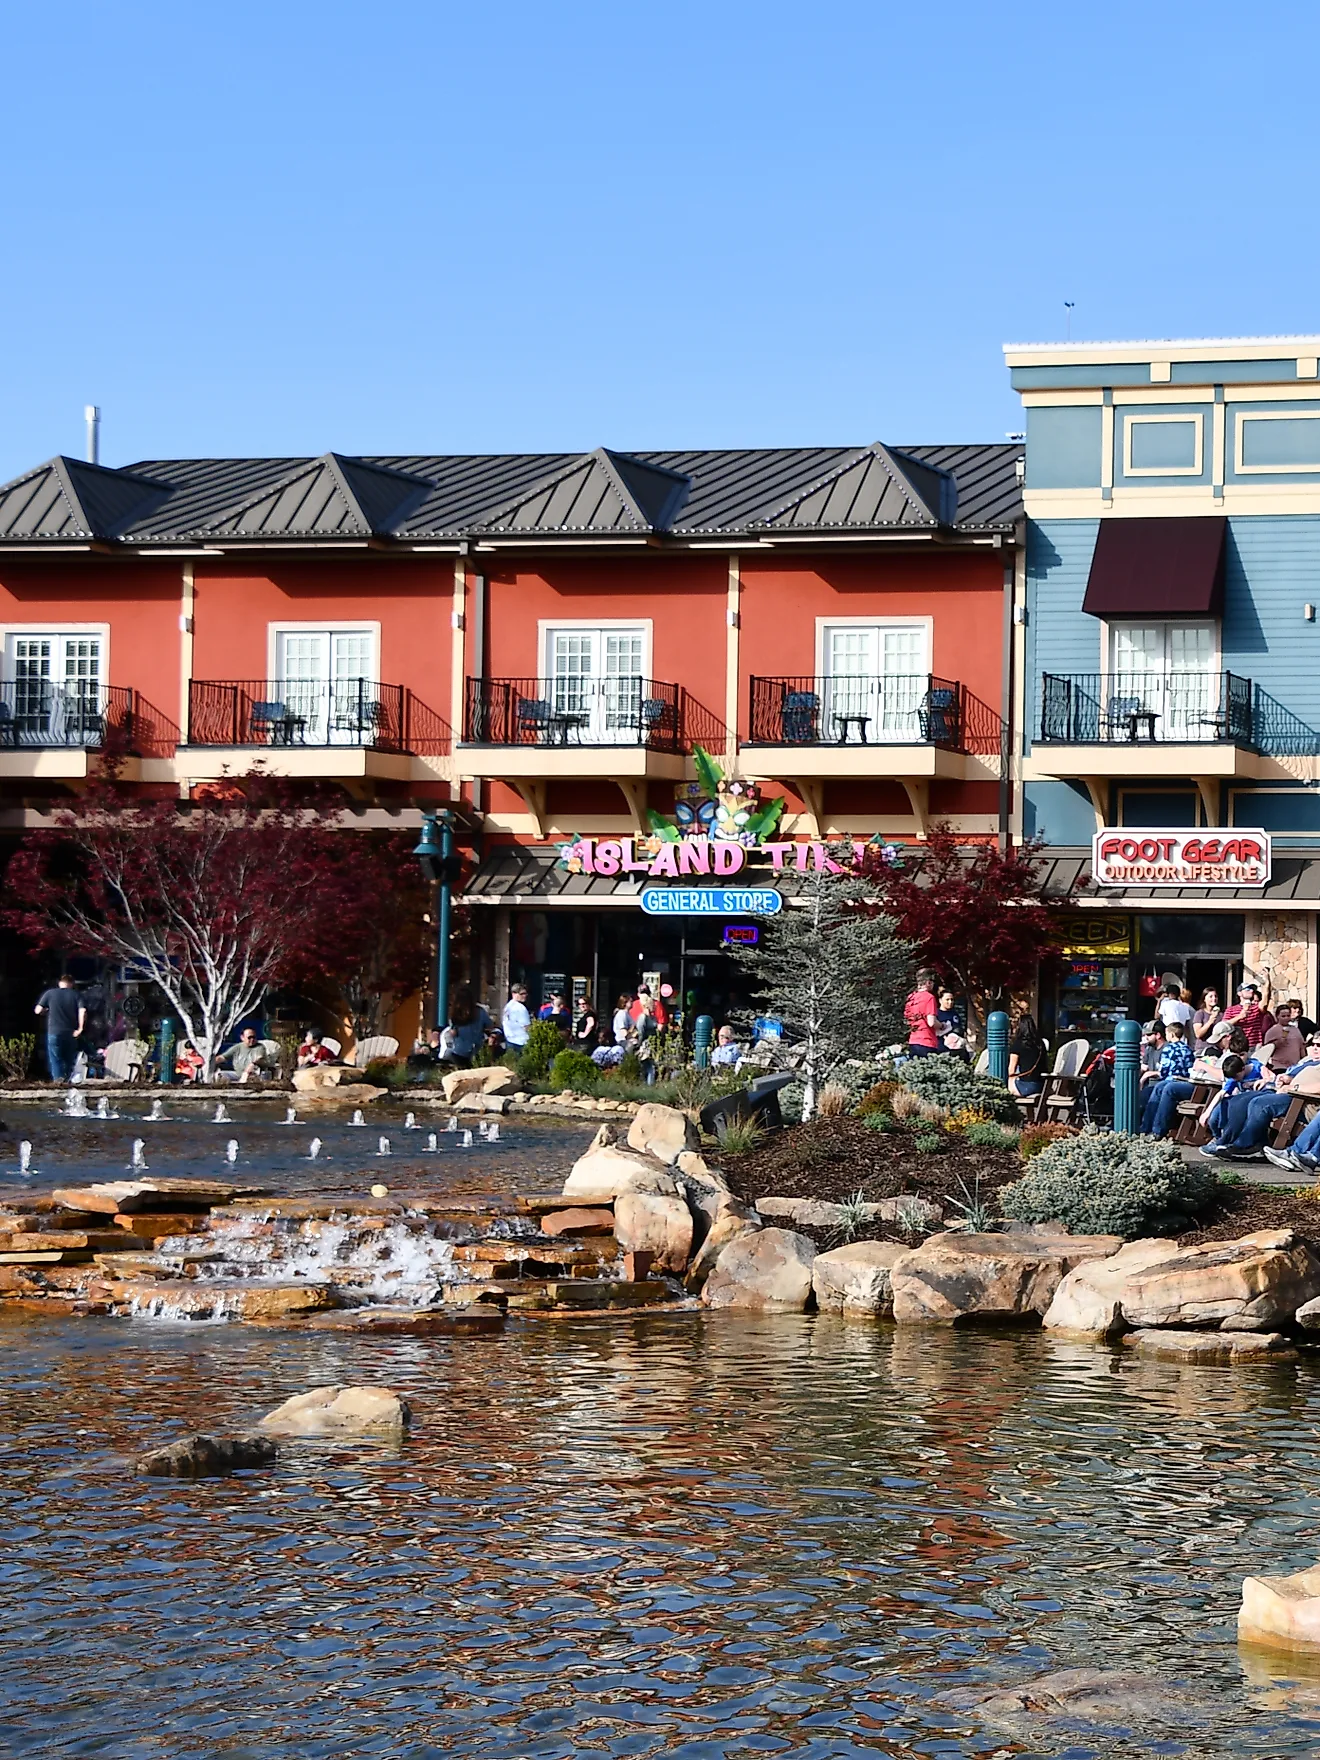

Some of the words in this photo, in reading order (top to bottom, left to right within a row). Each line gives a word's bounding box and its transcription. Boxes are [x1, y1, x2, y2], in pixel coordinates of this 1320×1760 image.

[582, 837, 745, 877] ISLAND
[1101, 838, 1176, 863] FOOT
[1181, 838, 1260, 863] GEAR
[1105, 866, 1177, 880] OUTDOOR
[1180, 865, 1258, 880] LIFESTYLE
[647, 891, 719, 911] GENERAL
[723, 890, 773, 911] STORE
[727, 929, 756, 940] OPEN
